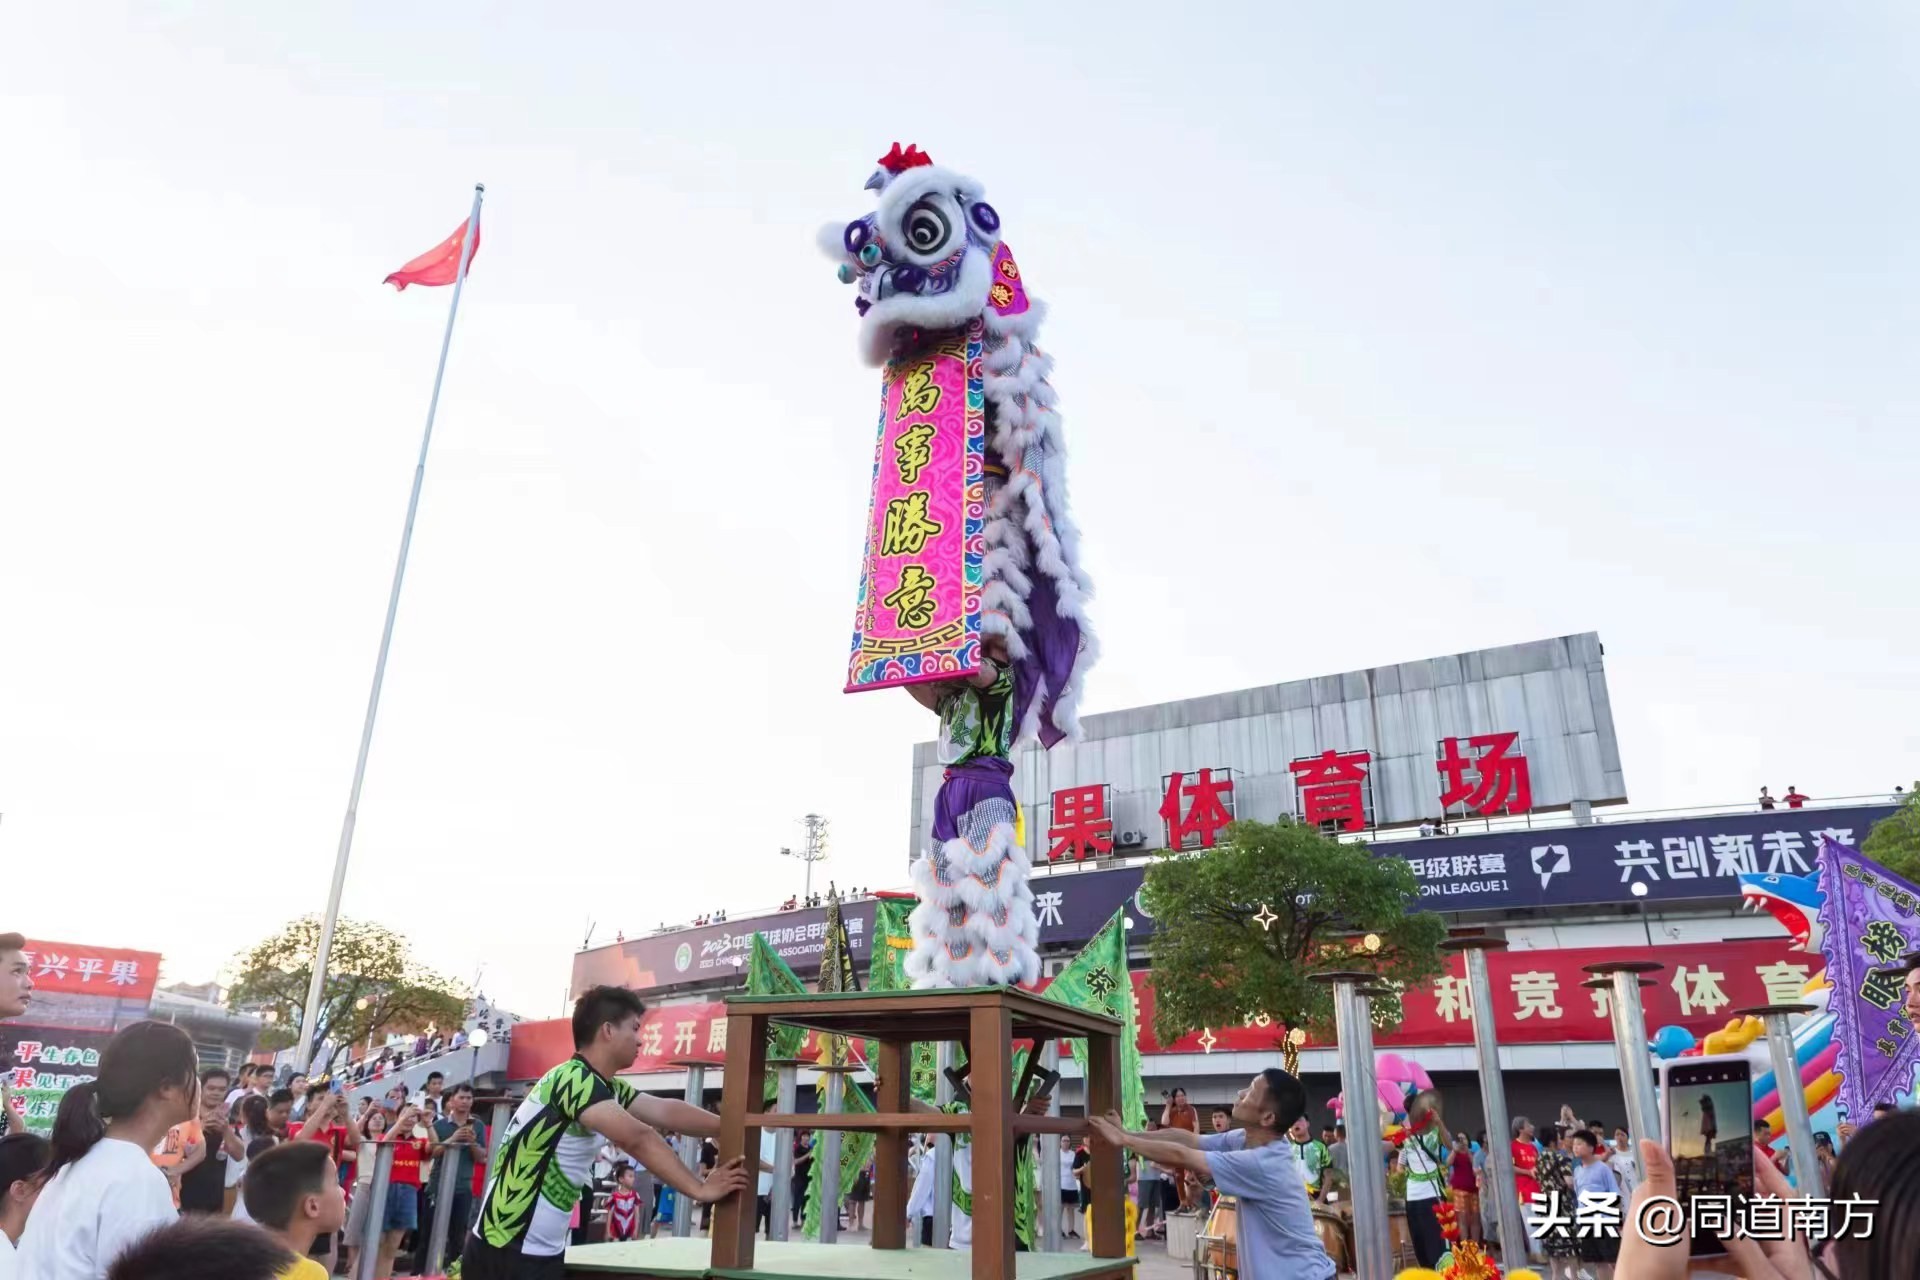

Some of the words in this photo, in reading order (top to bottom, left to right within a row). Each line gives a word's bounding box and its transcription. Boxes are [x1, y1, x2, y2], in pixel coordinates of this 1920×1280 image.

[882, 362, 942, 629] 萬事勝意
[1047, 732, 1532, 860] 果体育场
[1443, 880, 1500, 896] LEAGUE
[778, 943, 825, 957] ASSOCIATION
